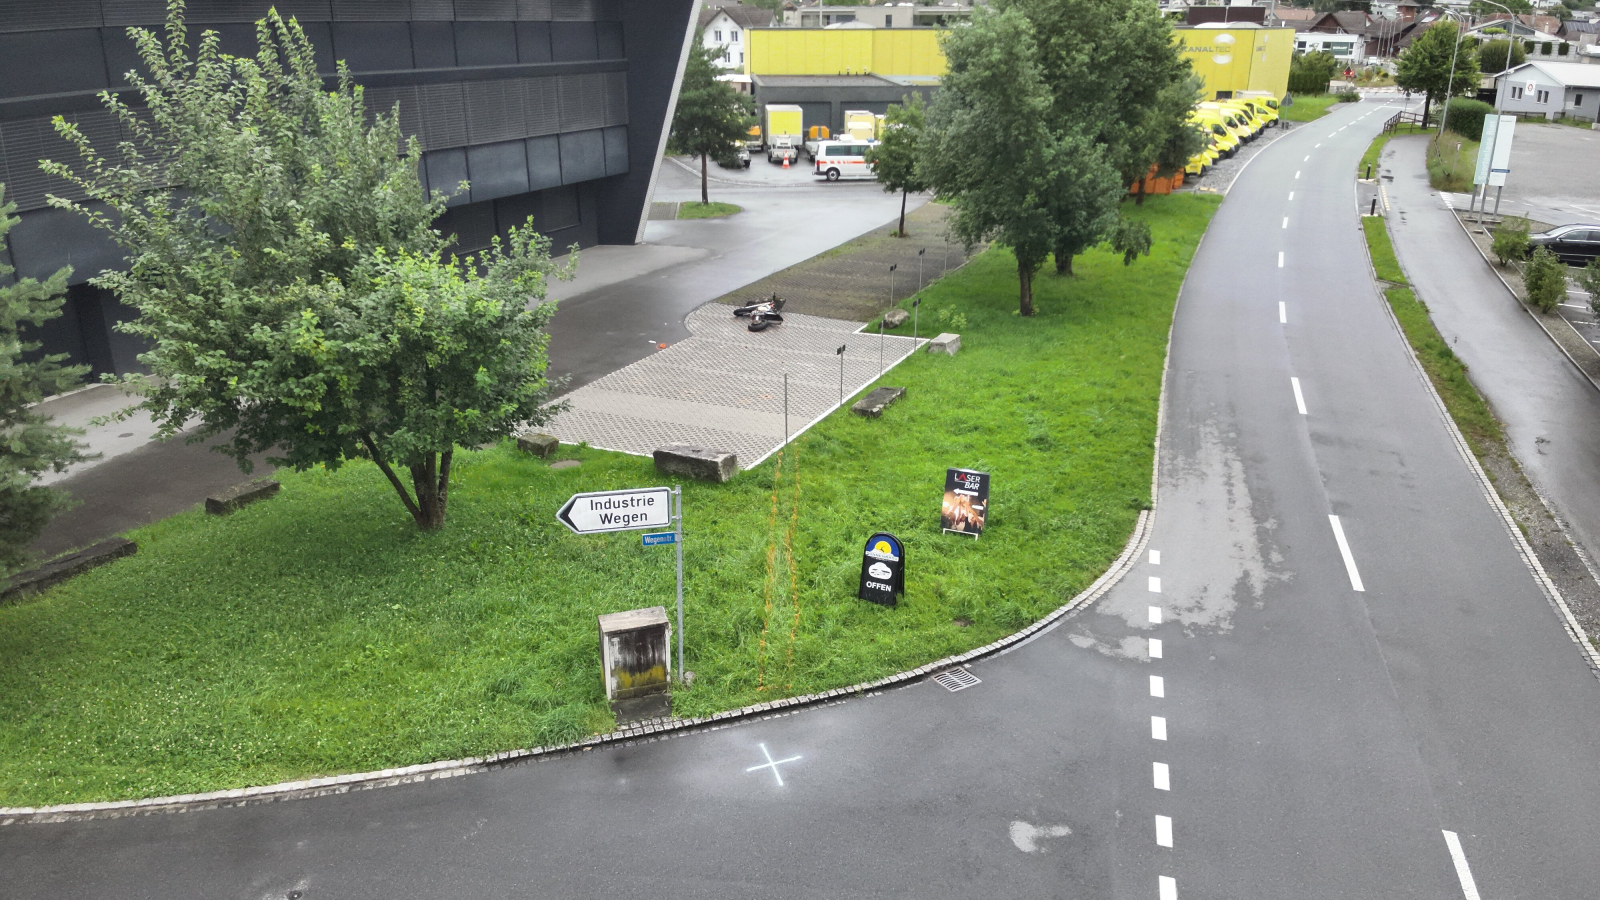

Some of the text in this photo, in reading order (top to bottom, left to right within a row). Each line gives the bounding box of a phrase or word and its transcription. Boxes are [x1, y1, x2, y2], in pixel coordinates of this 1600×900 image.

[954, 473, 980, 483] LASER
[964, 481, 980, 490] BAR
[590, 496, 655, 511] Industrie
[599, 512, 648, 526] Wegen
[866, 581, 892, 592] OFFEN
